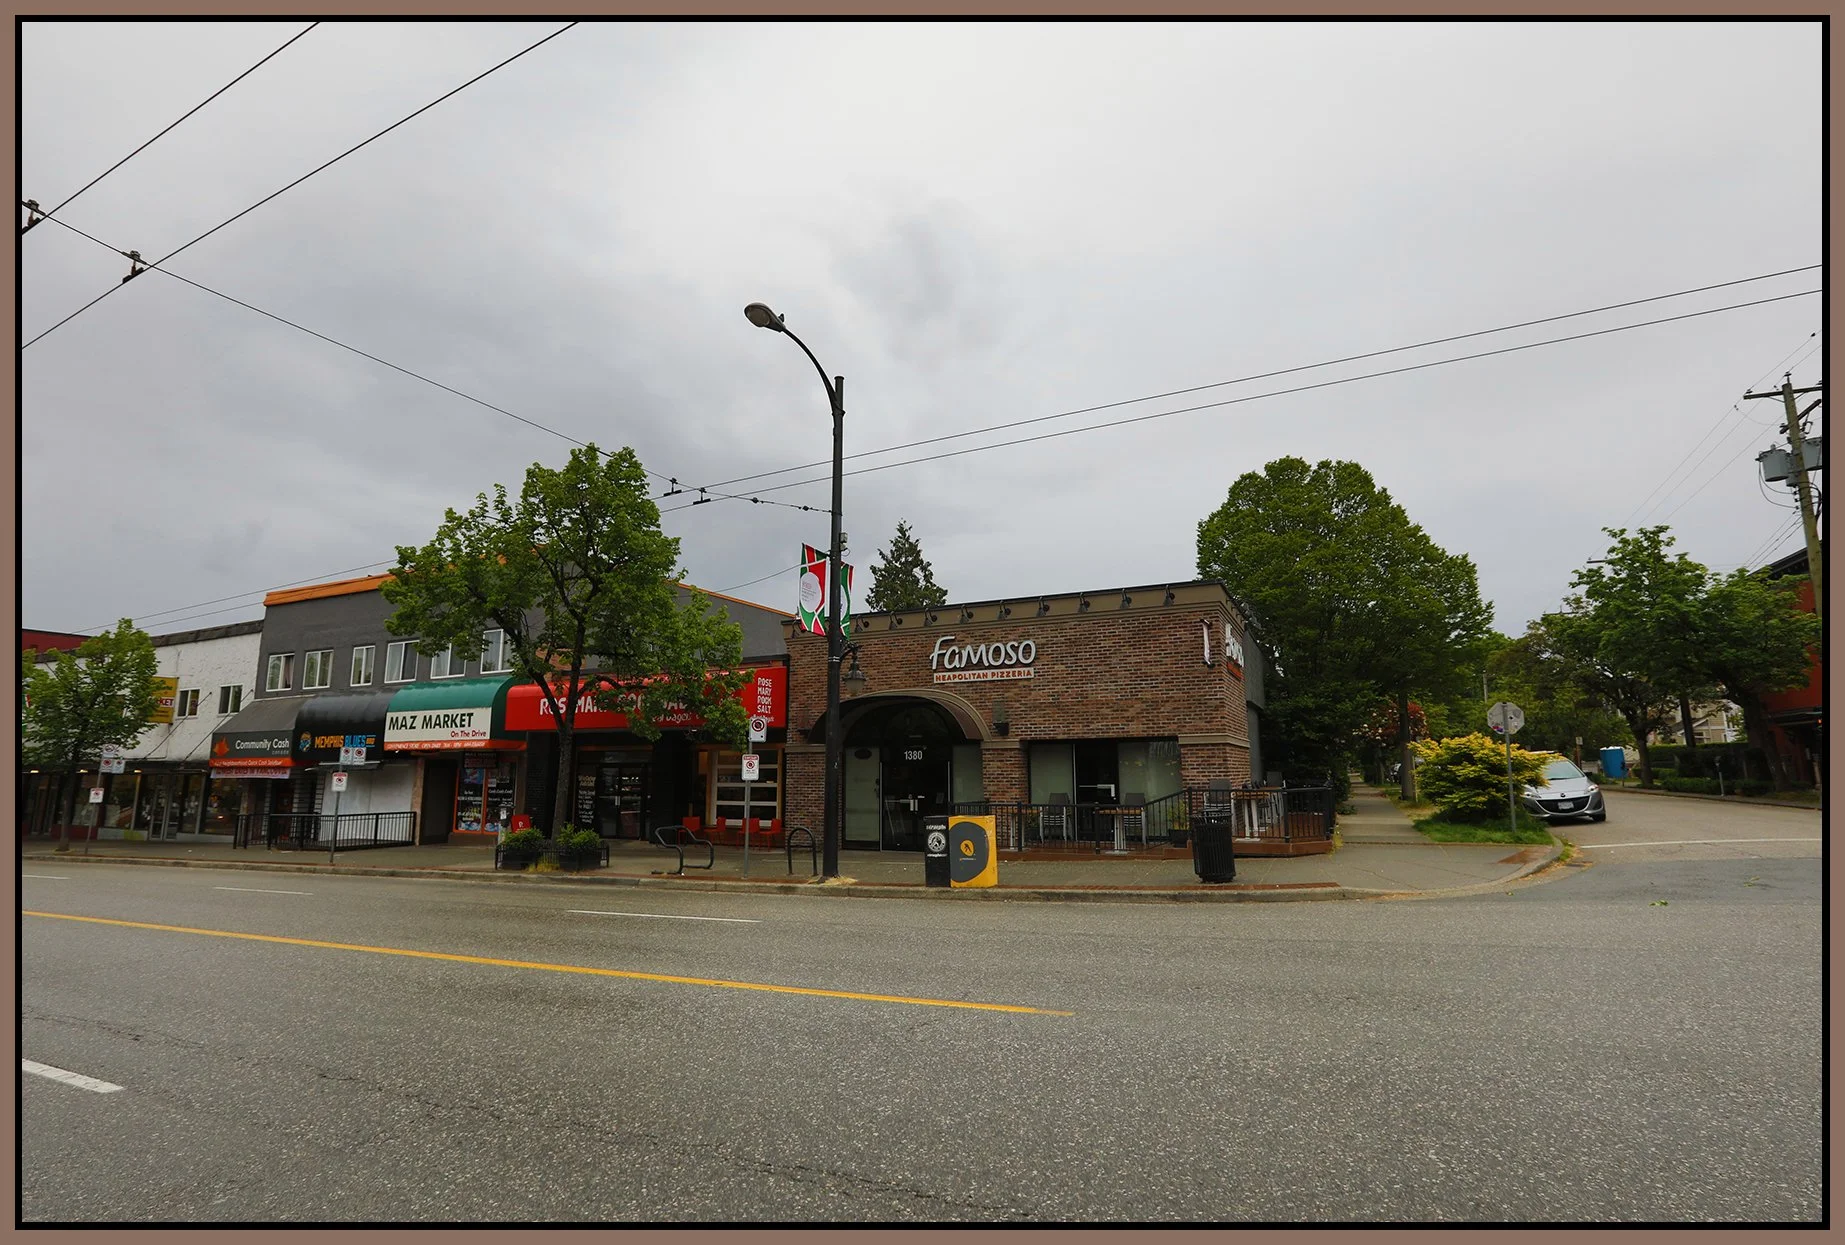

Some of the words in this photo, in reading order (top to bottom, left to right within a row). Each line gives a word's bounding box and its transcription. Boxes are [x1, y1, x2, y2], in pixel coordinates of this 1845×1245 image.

[935, 671, 989, 682] NEAPOLITAN
[990, 669, 1033, 678] PIZZERIA
[757, 677, 773, 688] ROSE
[757, 687, 773, 696] MARY
[757, 704, 772, 714] SALT
[388, 715, 418, 731] MAZ
[421, 712, 474, 730] MARKET
[450, 730, 460, 738] On
[460, 729, 470, 738] The
[471, 729, 487, 737] Drive
[235, 739, 271, 750] Community
[272, 738, 290, 748] Cash
[314, 735, 345, 748] MEMPHIS
[345, 735, 367, 748] BLUES
[904, 750, 923, 760] 1380
